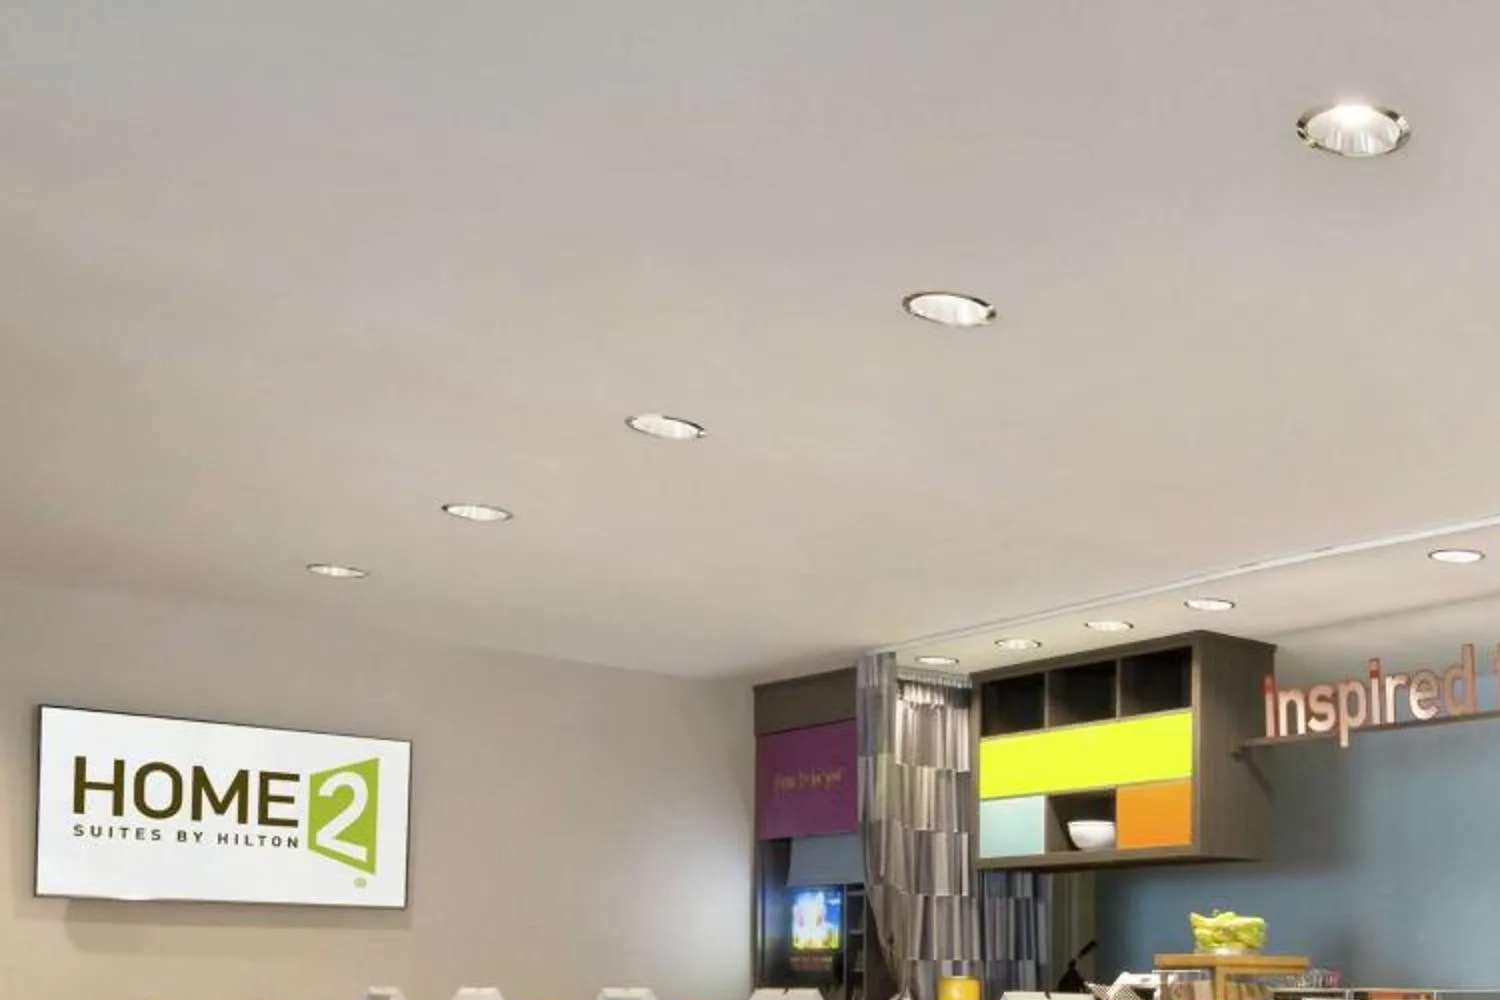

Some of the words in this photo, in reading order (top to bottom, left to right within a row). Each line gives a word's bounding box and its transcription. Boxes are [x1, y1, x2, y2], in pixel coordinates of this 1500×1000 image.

[1263, 642, 1476, 748] inspired
[73, 823, 162, 841] SUITES
[176, 829, 204, 843] BY
[217, 832, 299, 849] HILTON
